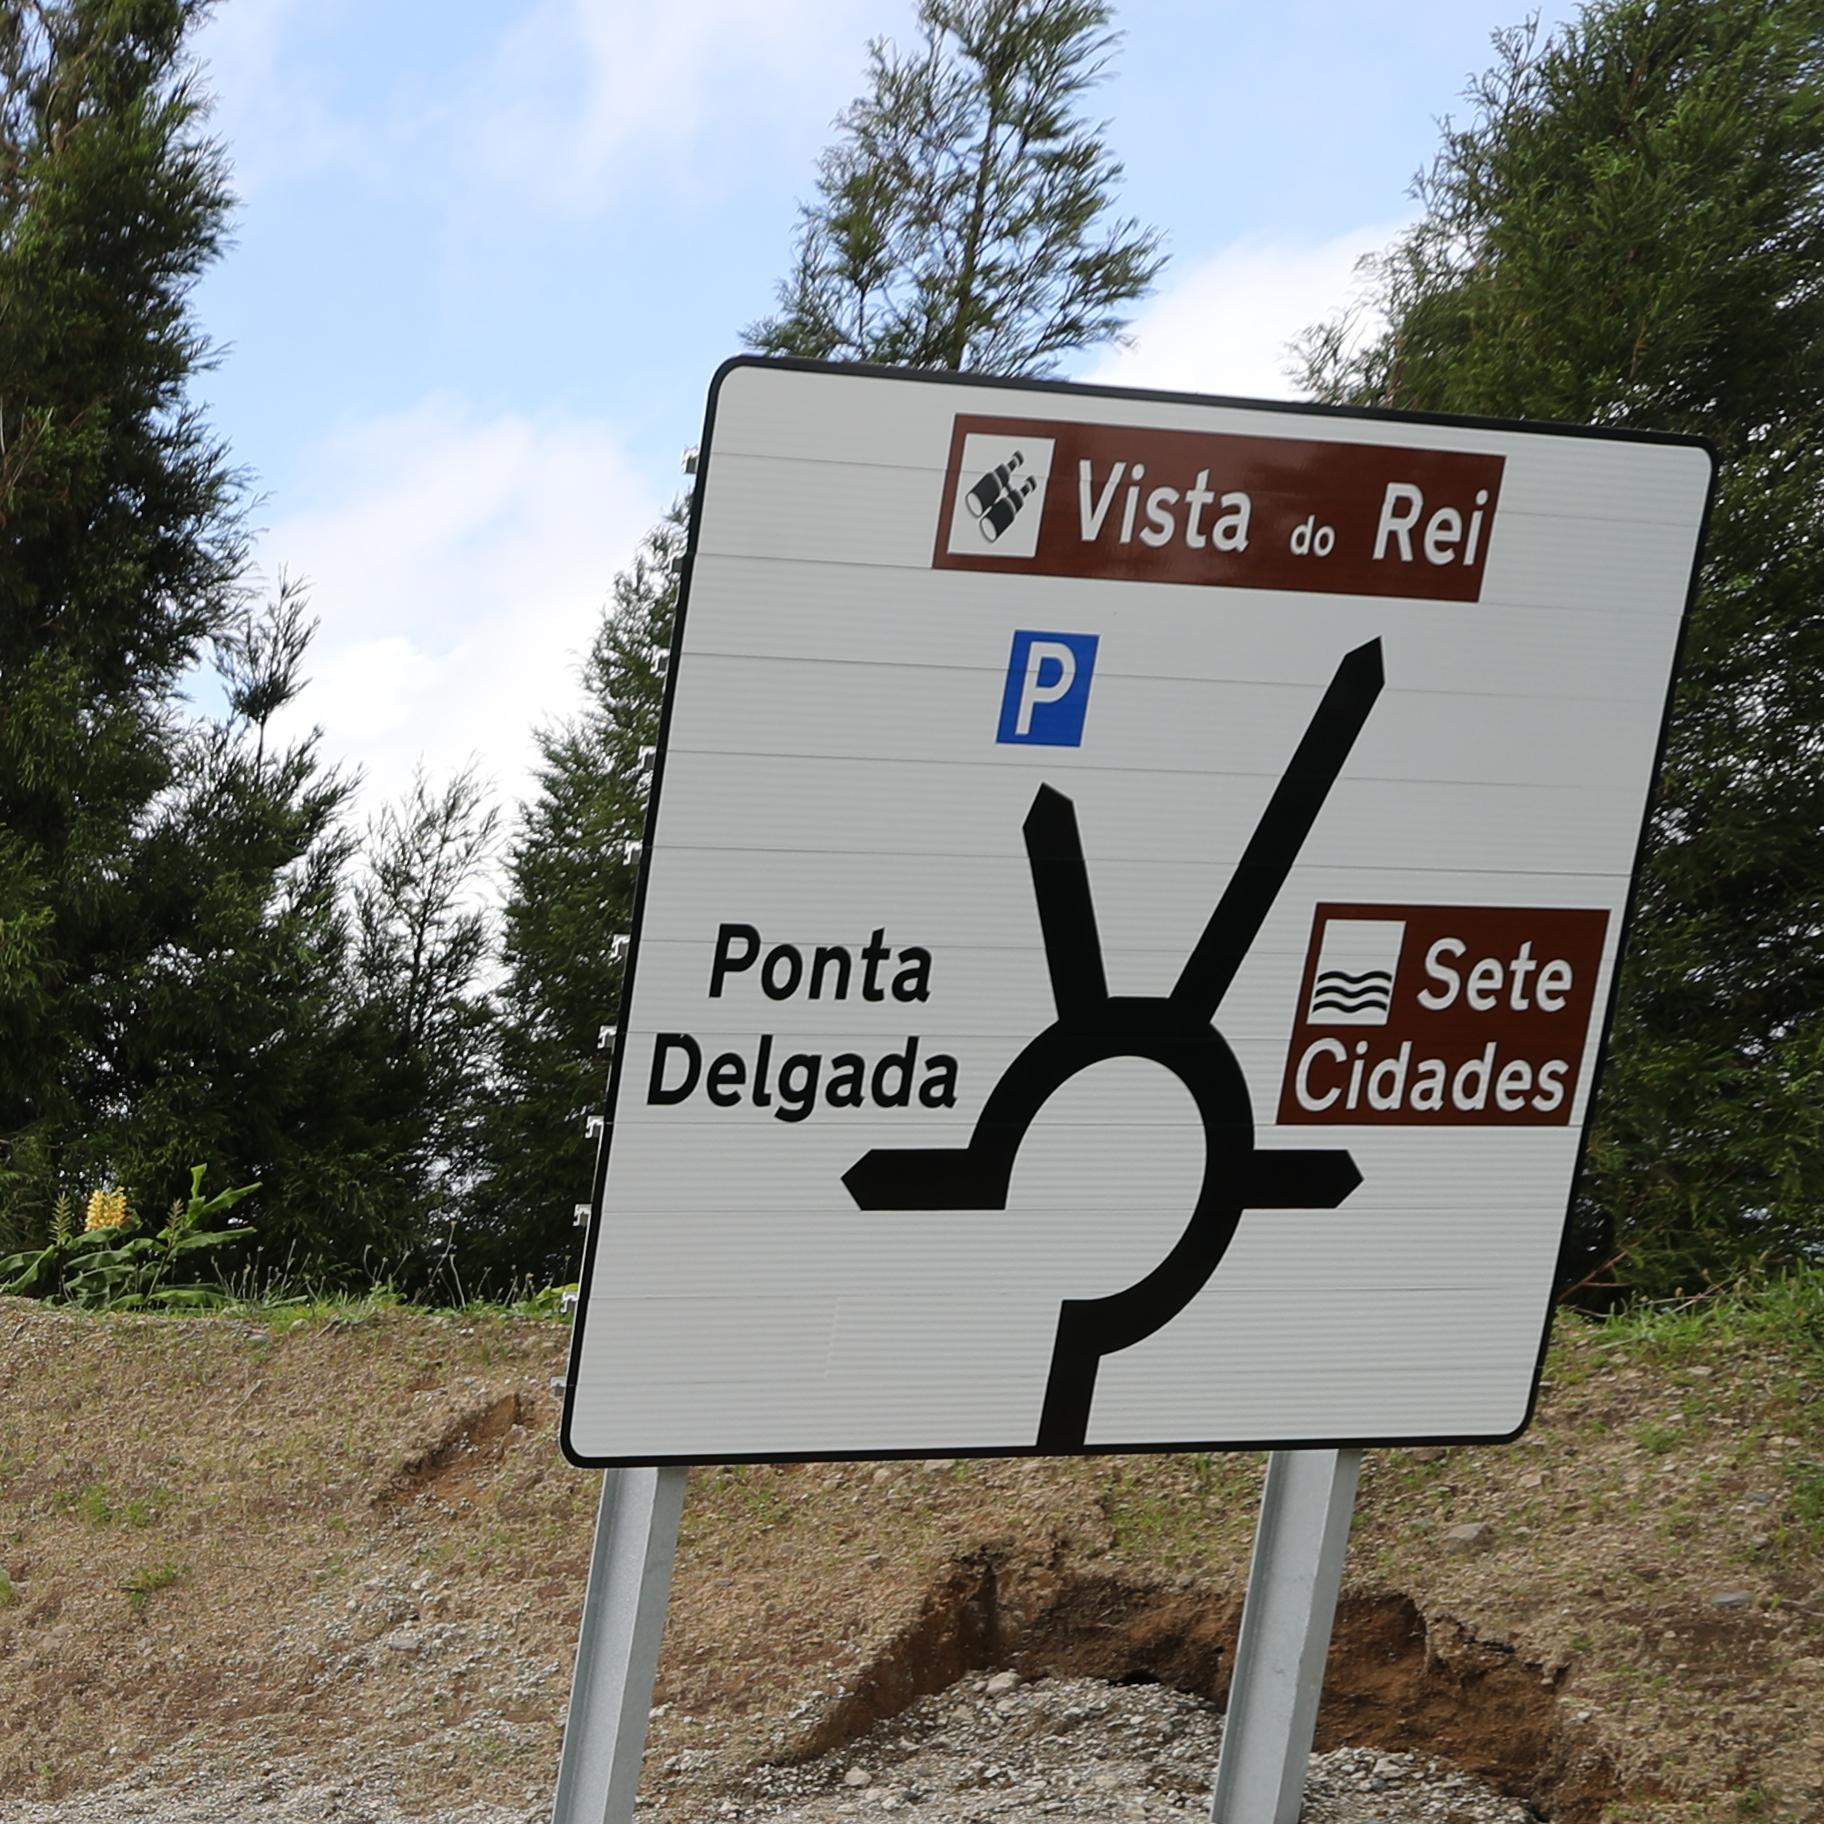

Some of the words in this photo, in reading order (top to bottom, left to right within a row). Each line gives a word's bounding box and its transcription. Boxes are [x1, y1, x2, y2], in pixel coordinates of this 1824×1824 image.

[1080, 460, 1251, 552] Vista
[1290, 515, 1335, 557] do
[1374, 483, 1488, 565] Rei
[1015, 641, 1076, 735] P
[708, 923, 932, 1003] Ponta
[1417, 937, 1572, 1012] Sete
[646, 1032, 958, 1124] Delgada
[1295, 1037, 1569, 1112] Cidades
